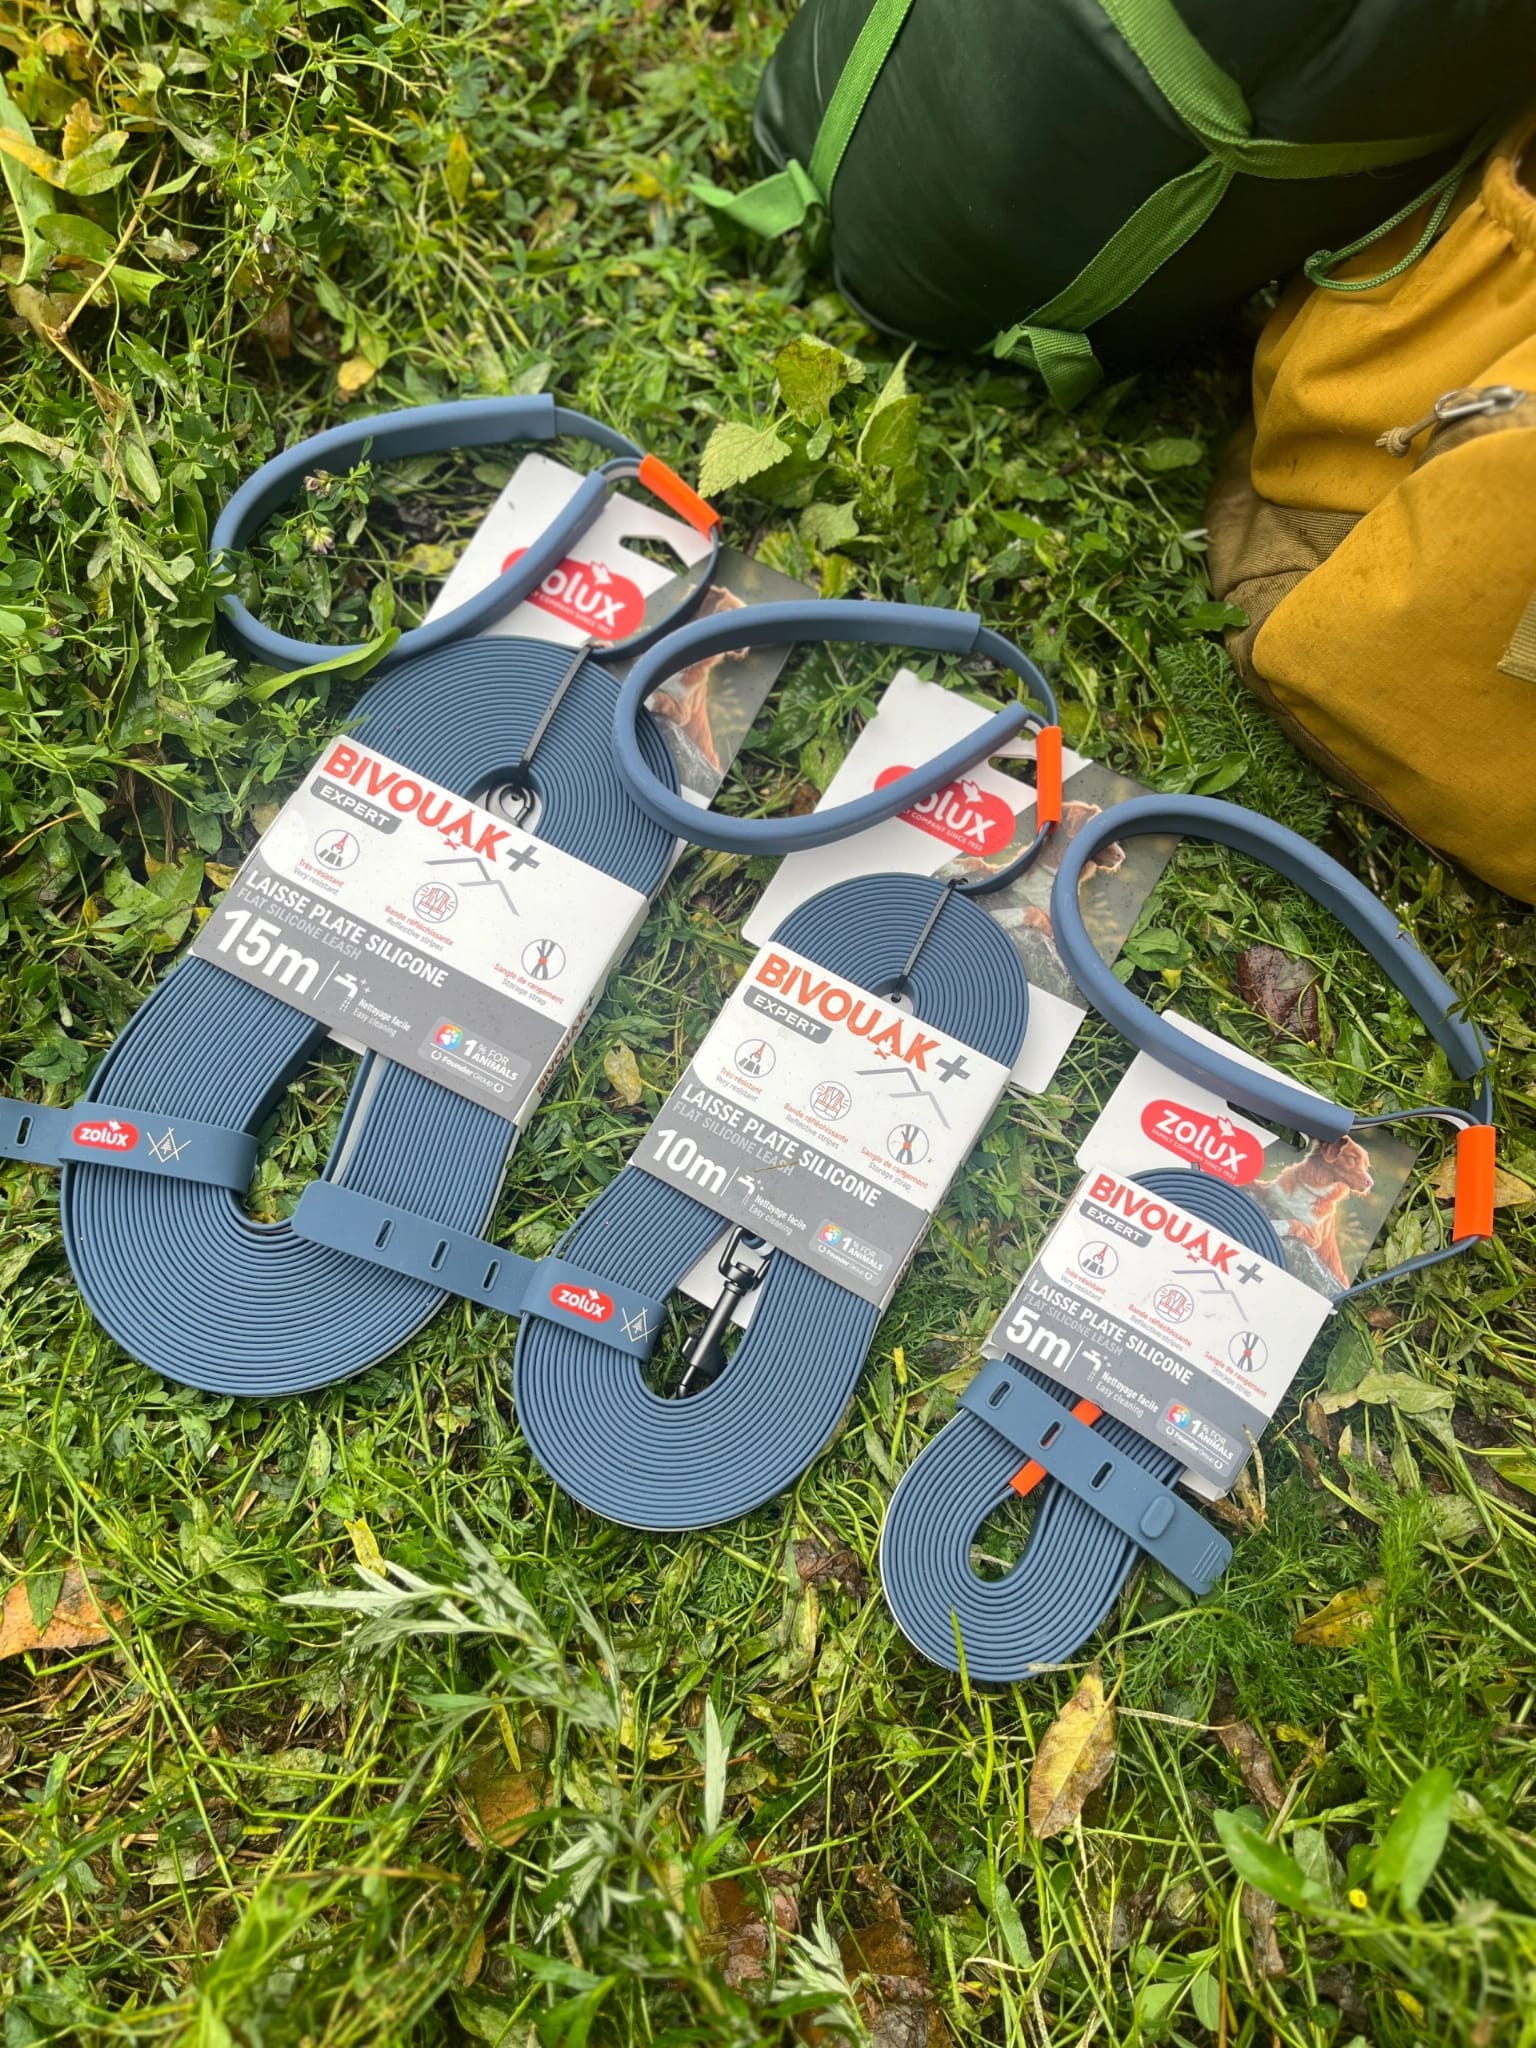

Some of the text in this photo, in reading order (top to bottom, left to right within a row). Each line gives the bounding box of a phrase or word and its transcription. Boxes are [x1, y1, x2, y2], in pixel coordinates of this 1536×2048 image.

[541, 568, 626, 626] olux
[320, 784, 391, 826] EXPERT
[914, 790, 996, 843] olux
[911, 811, 946, 832] COMPANY
[946, 829, 967, 844] SINCE
[237, 888, 362, 960] FLAT SILICONE LEASH
[246, 870, 449, 988] LAISSE PLATE SILICONE
[217, 909, 320, 994] 15m
[353, 1008, 397, 1038] Easy cleaning
[358, 998, 412, 1031] Nettoyage facile
[753, 994, 821, 1036] EXPERT
[442, 1056, 474, 1076] Founder
[472, 1052, 518, 1080] ANIMALS
[488, 1050, 510, 1066] FOR
[79, 1126, 130, 1147] zolux
[672, 1101, 796, 1176] FLAT SILICONE LEASH
[681, 1084, 882, 1207] LAISSE PLATE SILICONE
[1156, 1109, 1248, 1174] zolux
[653, 1128, 727, 1194] 10m
[750, 1204, 792, 1236] Easy cleaning
[754, 1195, 808, 1230] Nettoyage facile
[1086, 1206, 1144, 1242] EXPERT
[850, 1248, 884, 1271] ANIMALS
[860, 1244, 876, 1256] FOR
[558, 1288, 606, 1318] zolux
[1006, 1306, 1070, 1369] 5m
[1022, 1293, 1124, 1357] FLAT SILICONE LEASH
[1030, 1279, 1194, 1386] LAISSE PLATE SILICONE
[1096, 1381, 1144, 1418] Easy cleaning
[1101, 1371, 1160, 1413] Nettoyage facile
[1198, 1433, 1234, 1460] ANIMALS
[1210, 1430, 1227, 1444] FOR
